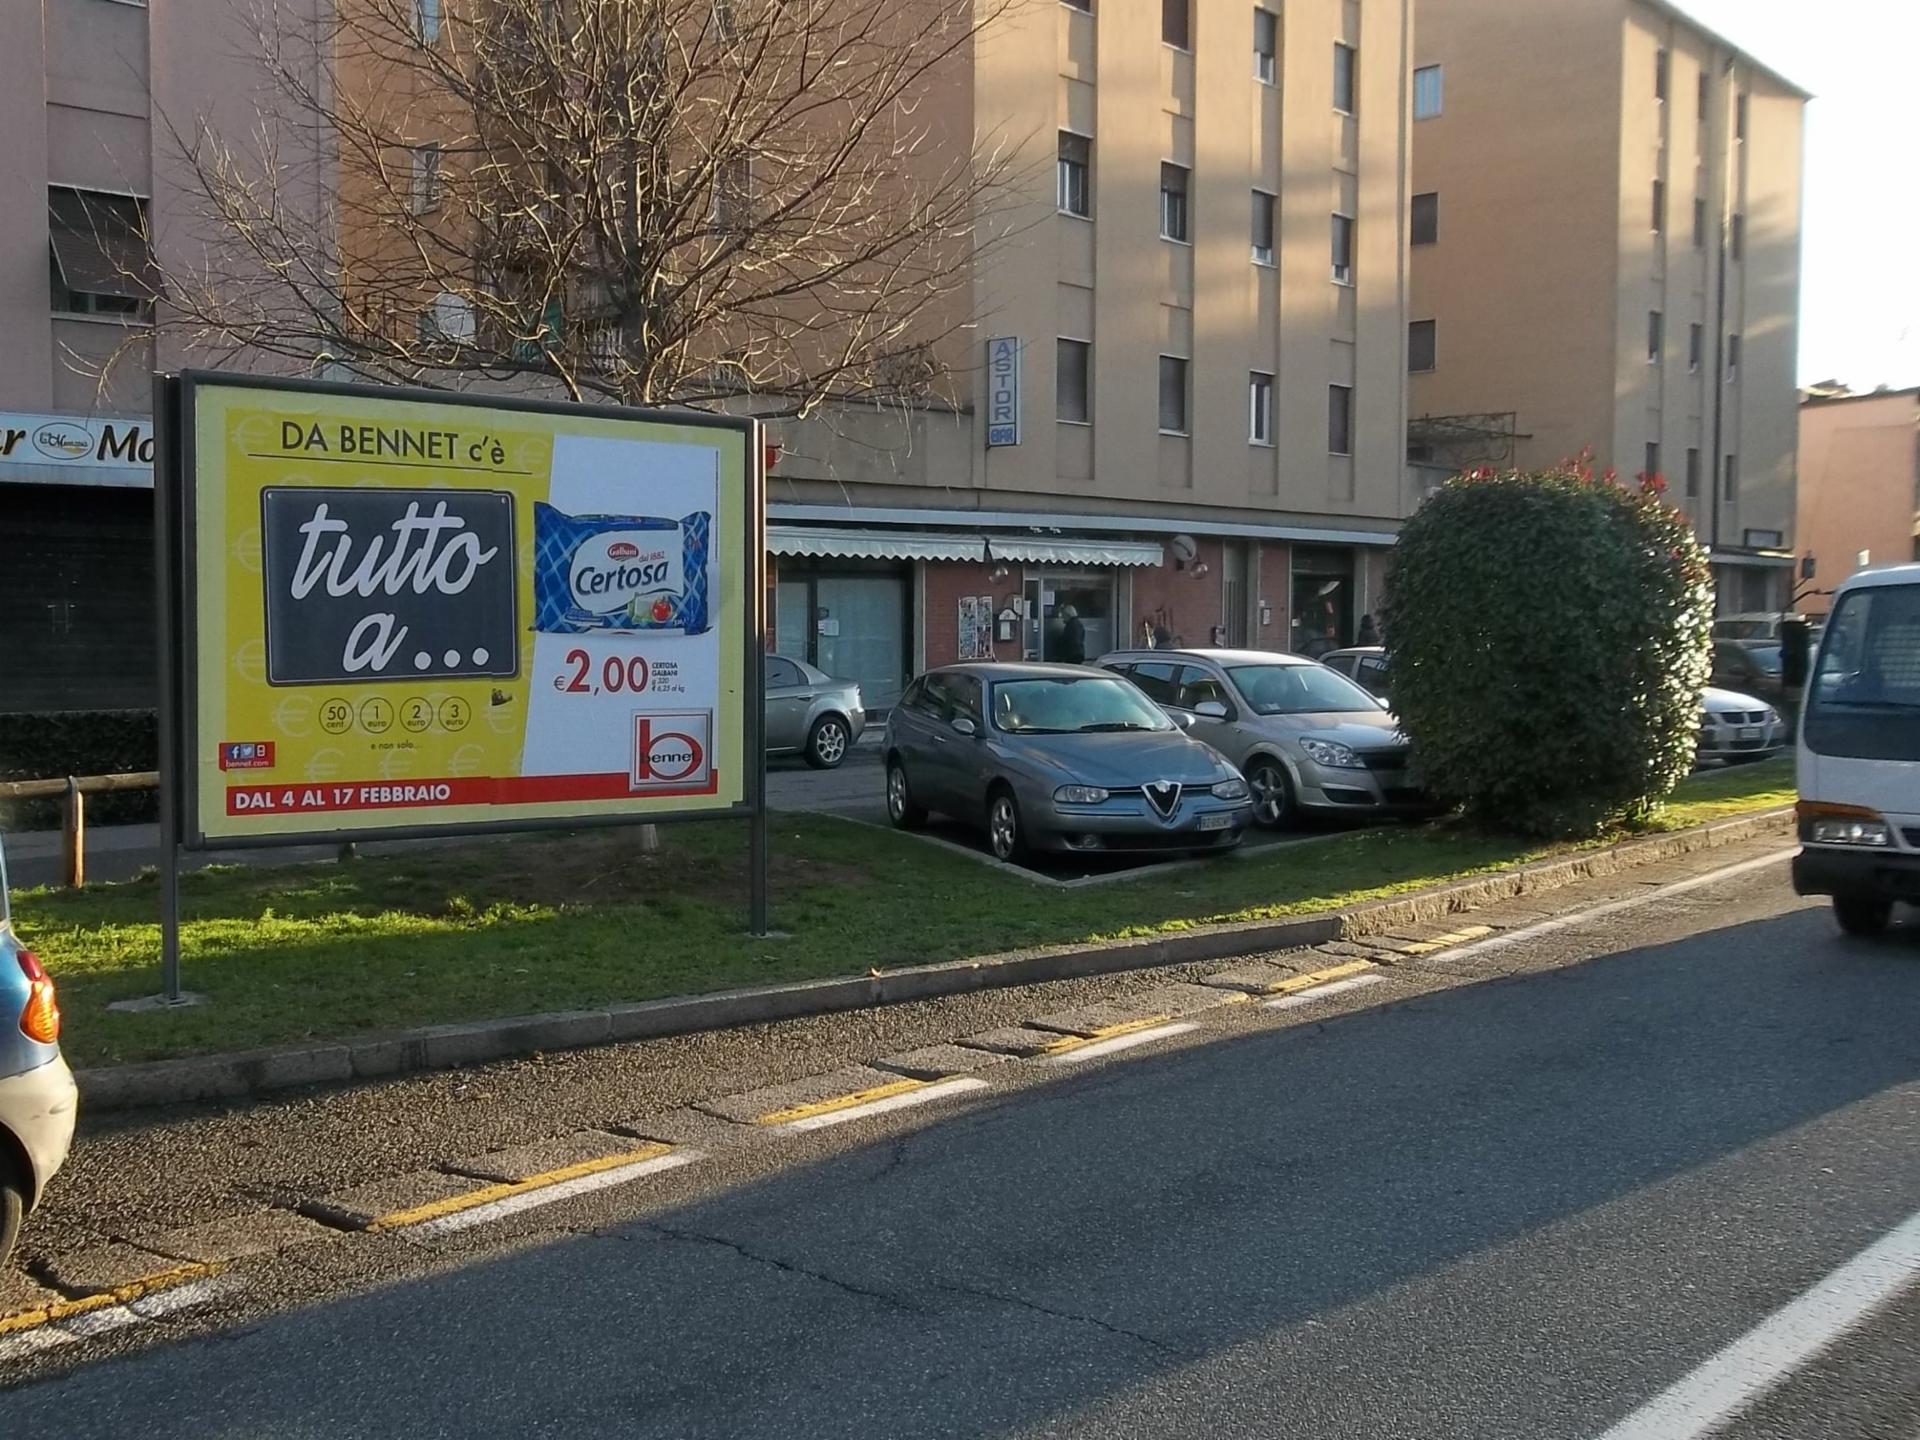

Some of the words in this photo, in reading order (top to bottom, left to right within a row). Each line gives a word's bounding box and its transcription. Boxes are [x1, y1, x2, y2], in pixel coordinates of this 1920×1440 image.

[993, 340, 1012, 422] ASTOR
[282, 421, 329, 452] DA
[340, 425, 459, 460] BENNET
[469, 435, 505, 465] c'è
[290, 500, 498, 600] tutto
[575, 560, 669, 597] Certosa
[327, 705, 347, 721] 50
[373, 705, 379, 720] 1
[412, 704, 421, 719] 2
[450, 703, 459, 719] 3
[326, 720, 344, 729] cent
[367, 720, 387, 728] euro
[407, 719, 426, 727] euro
[378, 742, 394, 750] non
[225, 759, 269, 768] bennet.com
[235, 791, 276, 809] DAL
[281, 790, 295, 807] 4
[301, 789, 326, 806] AL
[333, 787, 355, 805] 17
[360, 783, 451, 804] FEBBRAIO
